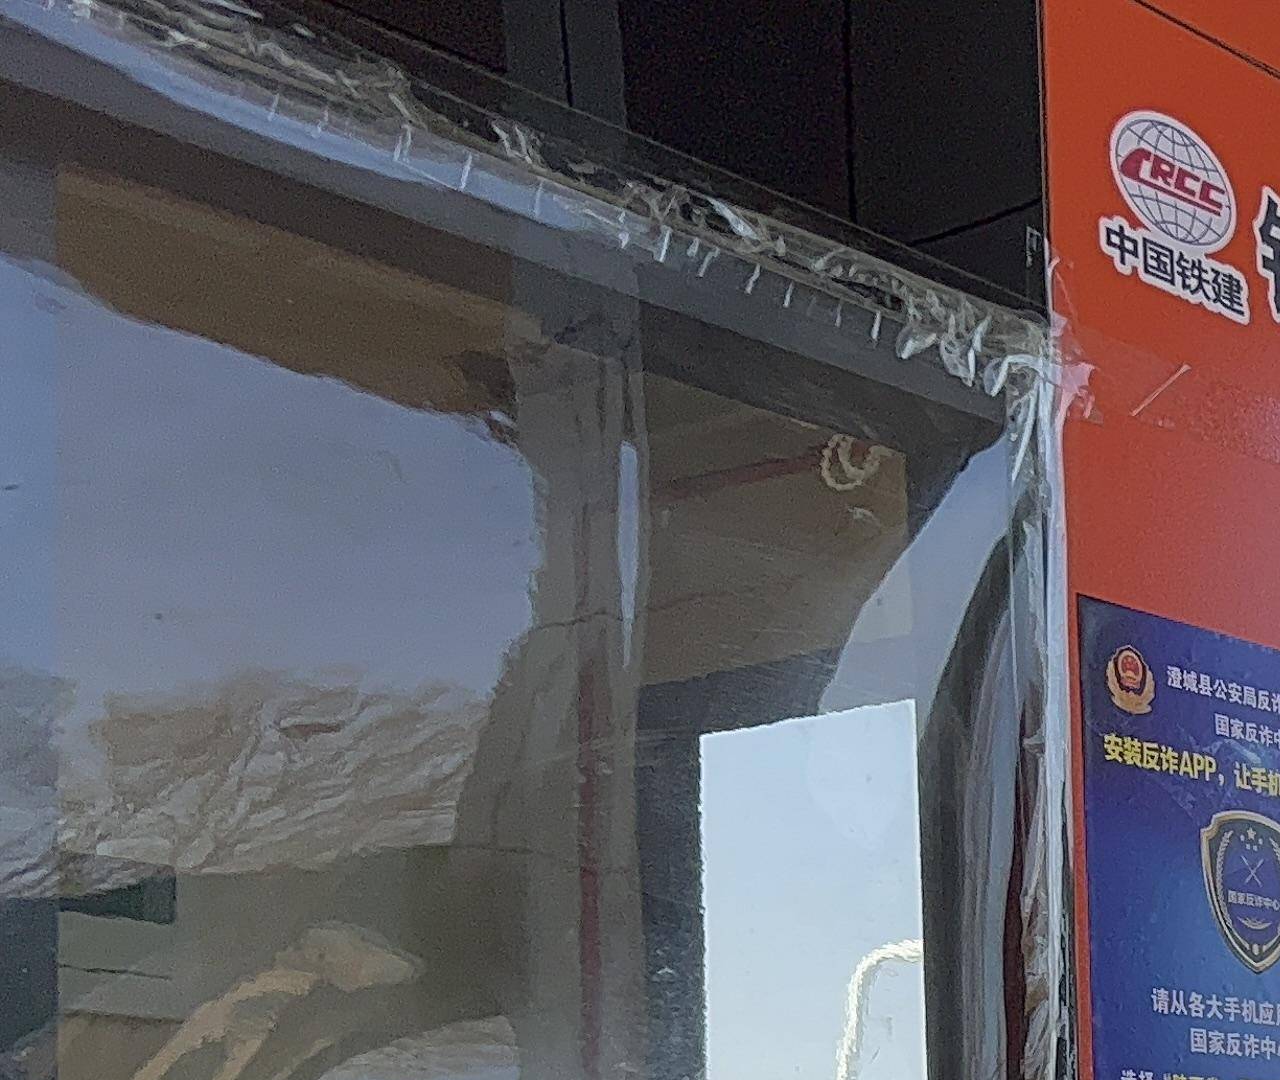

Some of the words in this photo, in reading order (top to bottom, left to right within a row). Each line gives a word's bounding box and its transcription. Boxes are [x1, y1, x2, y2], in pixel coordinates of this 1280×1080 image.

[1120, 148, 1226, 213] CRCC
[1105, 224, 1245, 317] 中国铁建
